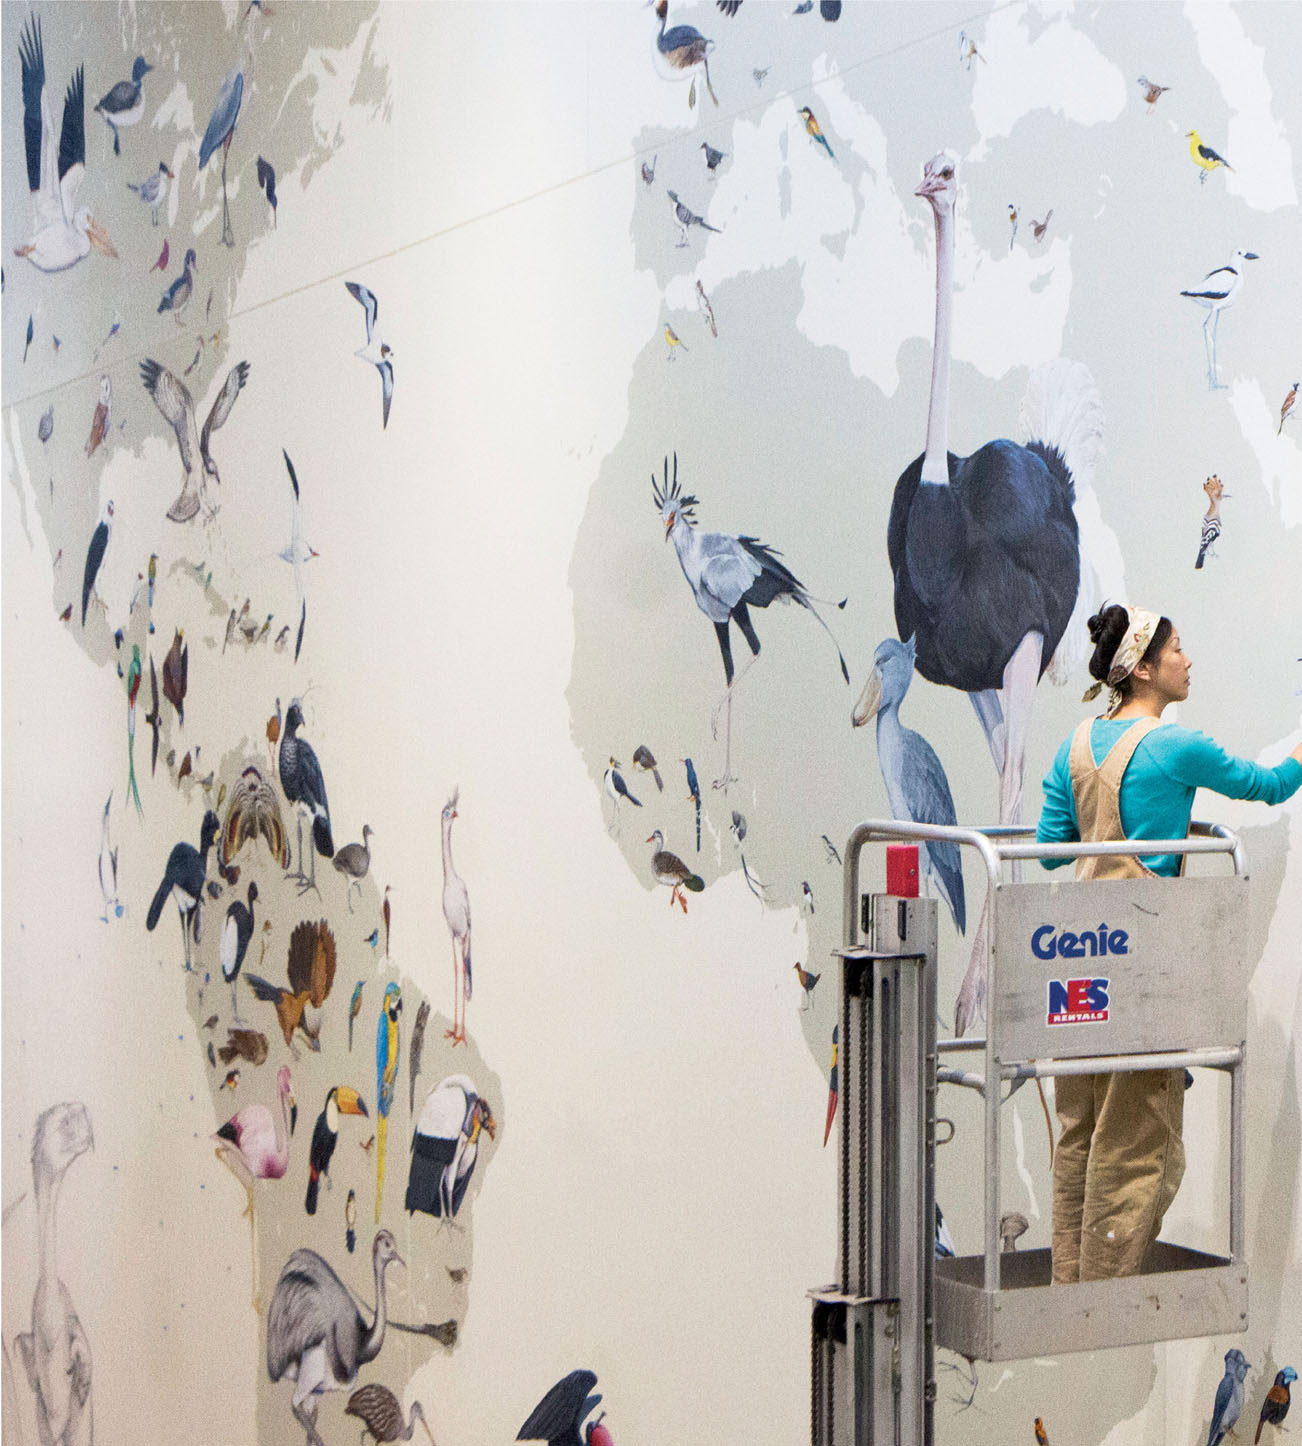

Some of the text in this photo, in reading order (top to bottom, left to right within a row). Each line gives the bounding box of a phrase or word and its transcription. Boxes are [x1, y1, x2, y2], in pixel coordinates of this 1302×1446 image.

[1031, 922, 1129, 960] Genie
[1049, 979, 1109, 1013] NES
[1053, 1012, 1104, 1022] RENTALS
